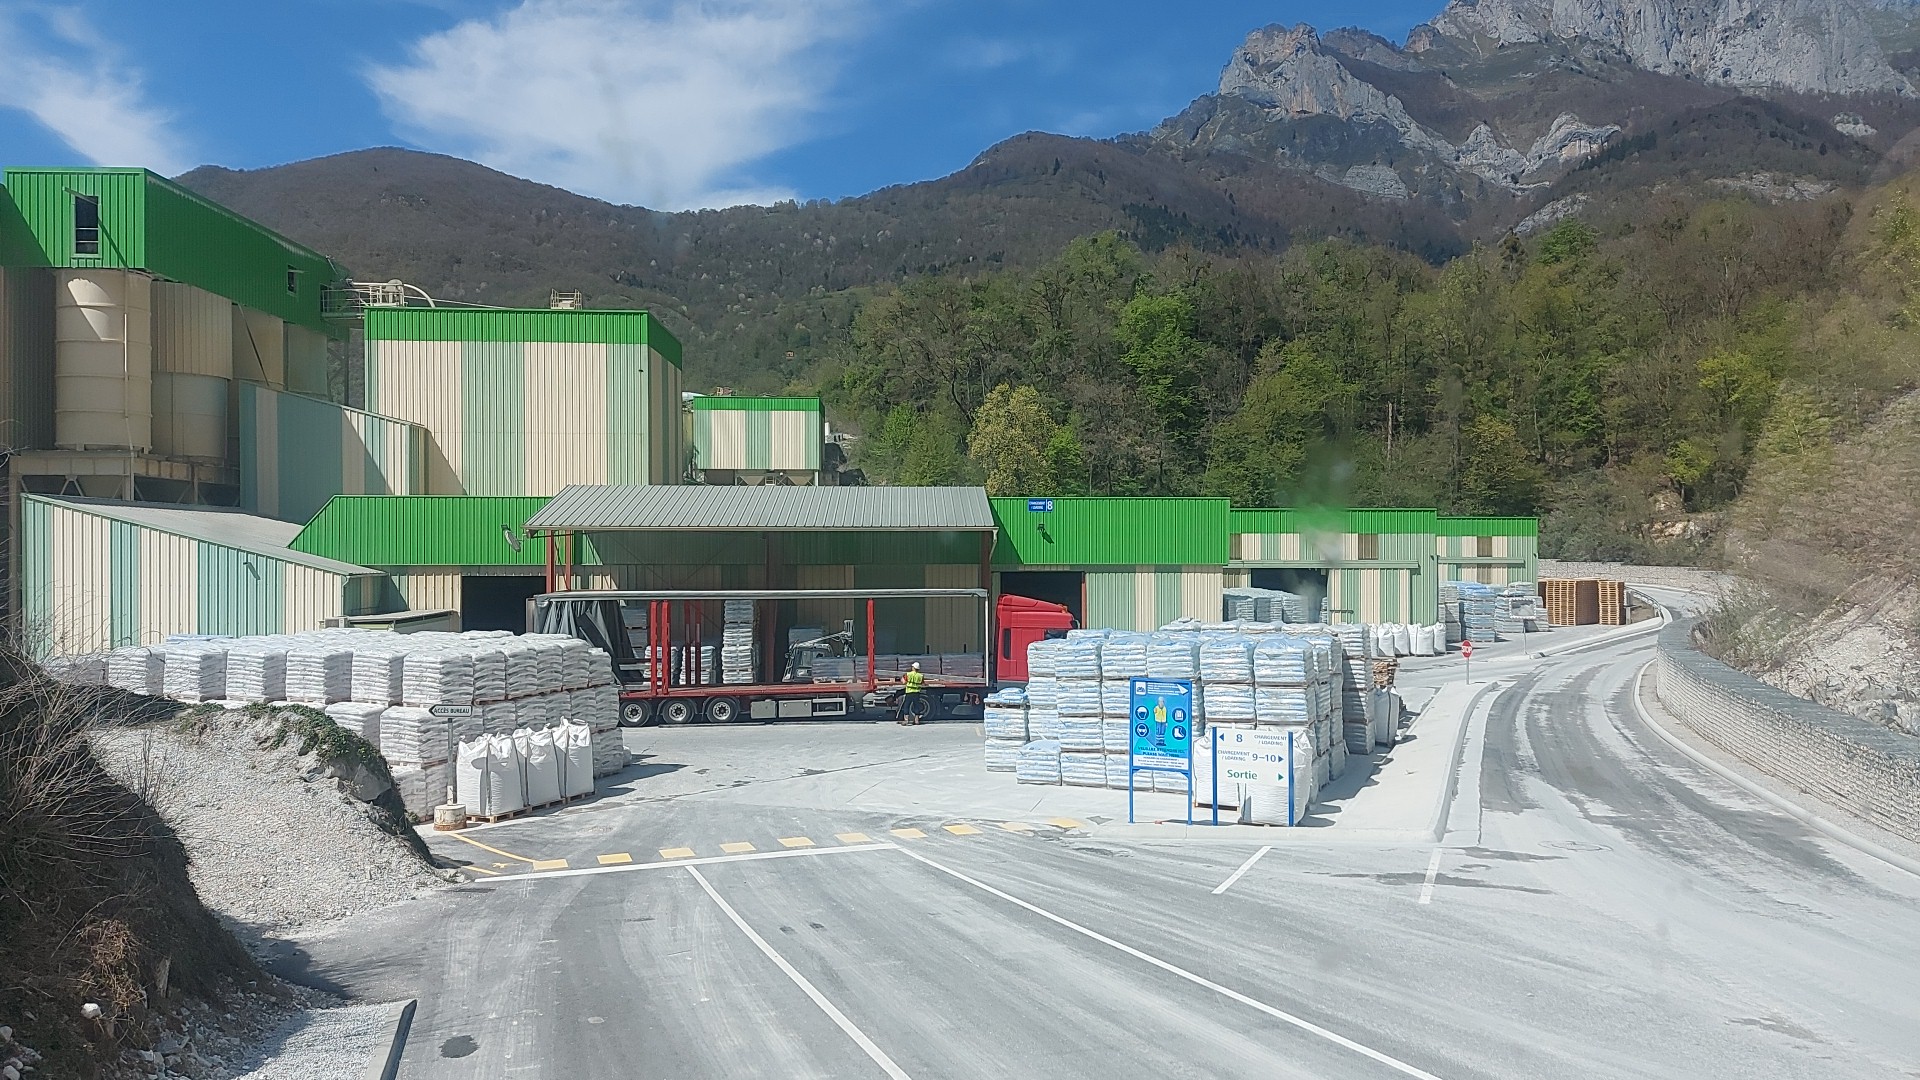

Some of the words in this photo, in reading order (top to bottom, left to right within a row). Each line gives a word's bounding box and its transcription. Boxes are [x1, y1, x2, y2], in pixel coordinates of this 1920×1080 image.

[1047, 500, 1053, 510] 8
[1236, 734, 1243, 742] 8
[1227, 770, 1258, 779] Sortie
